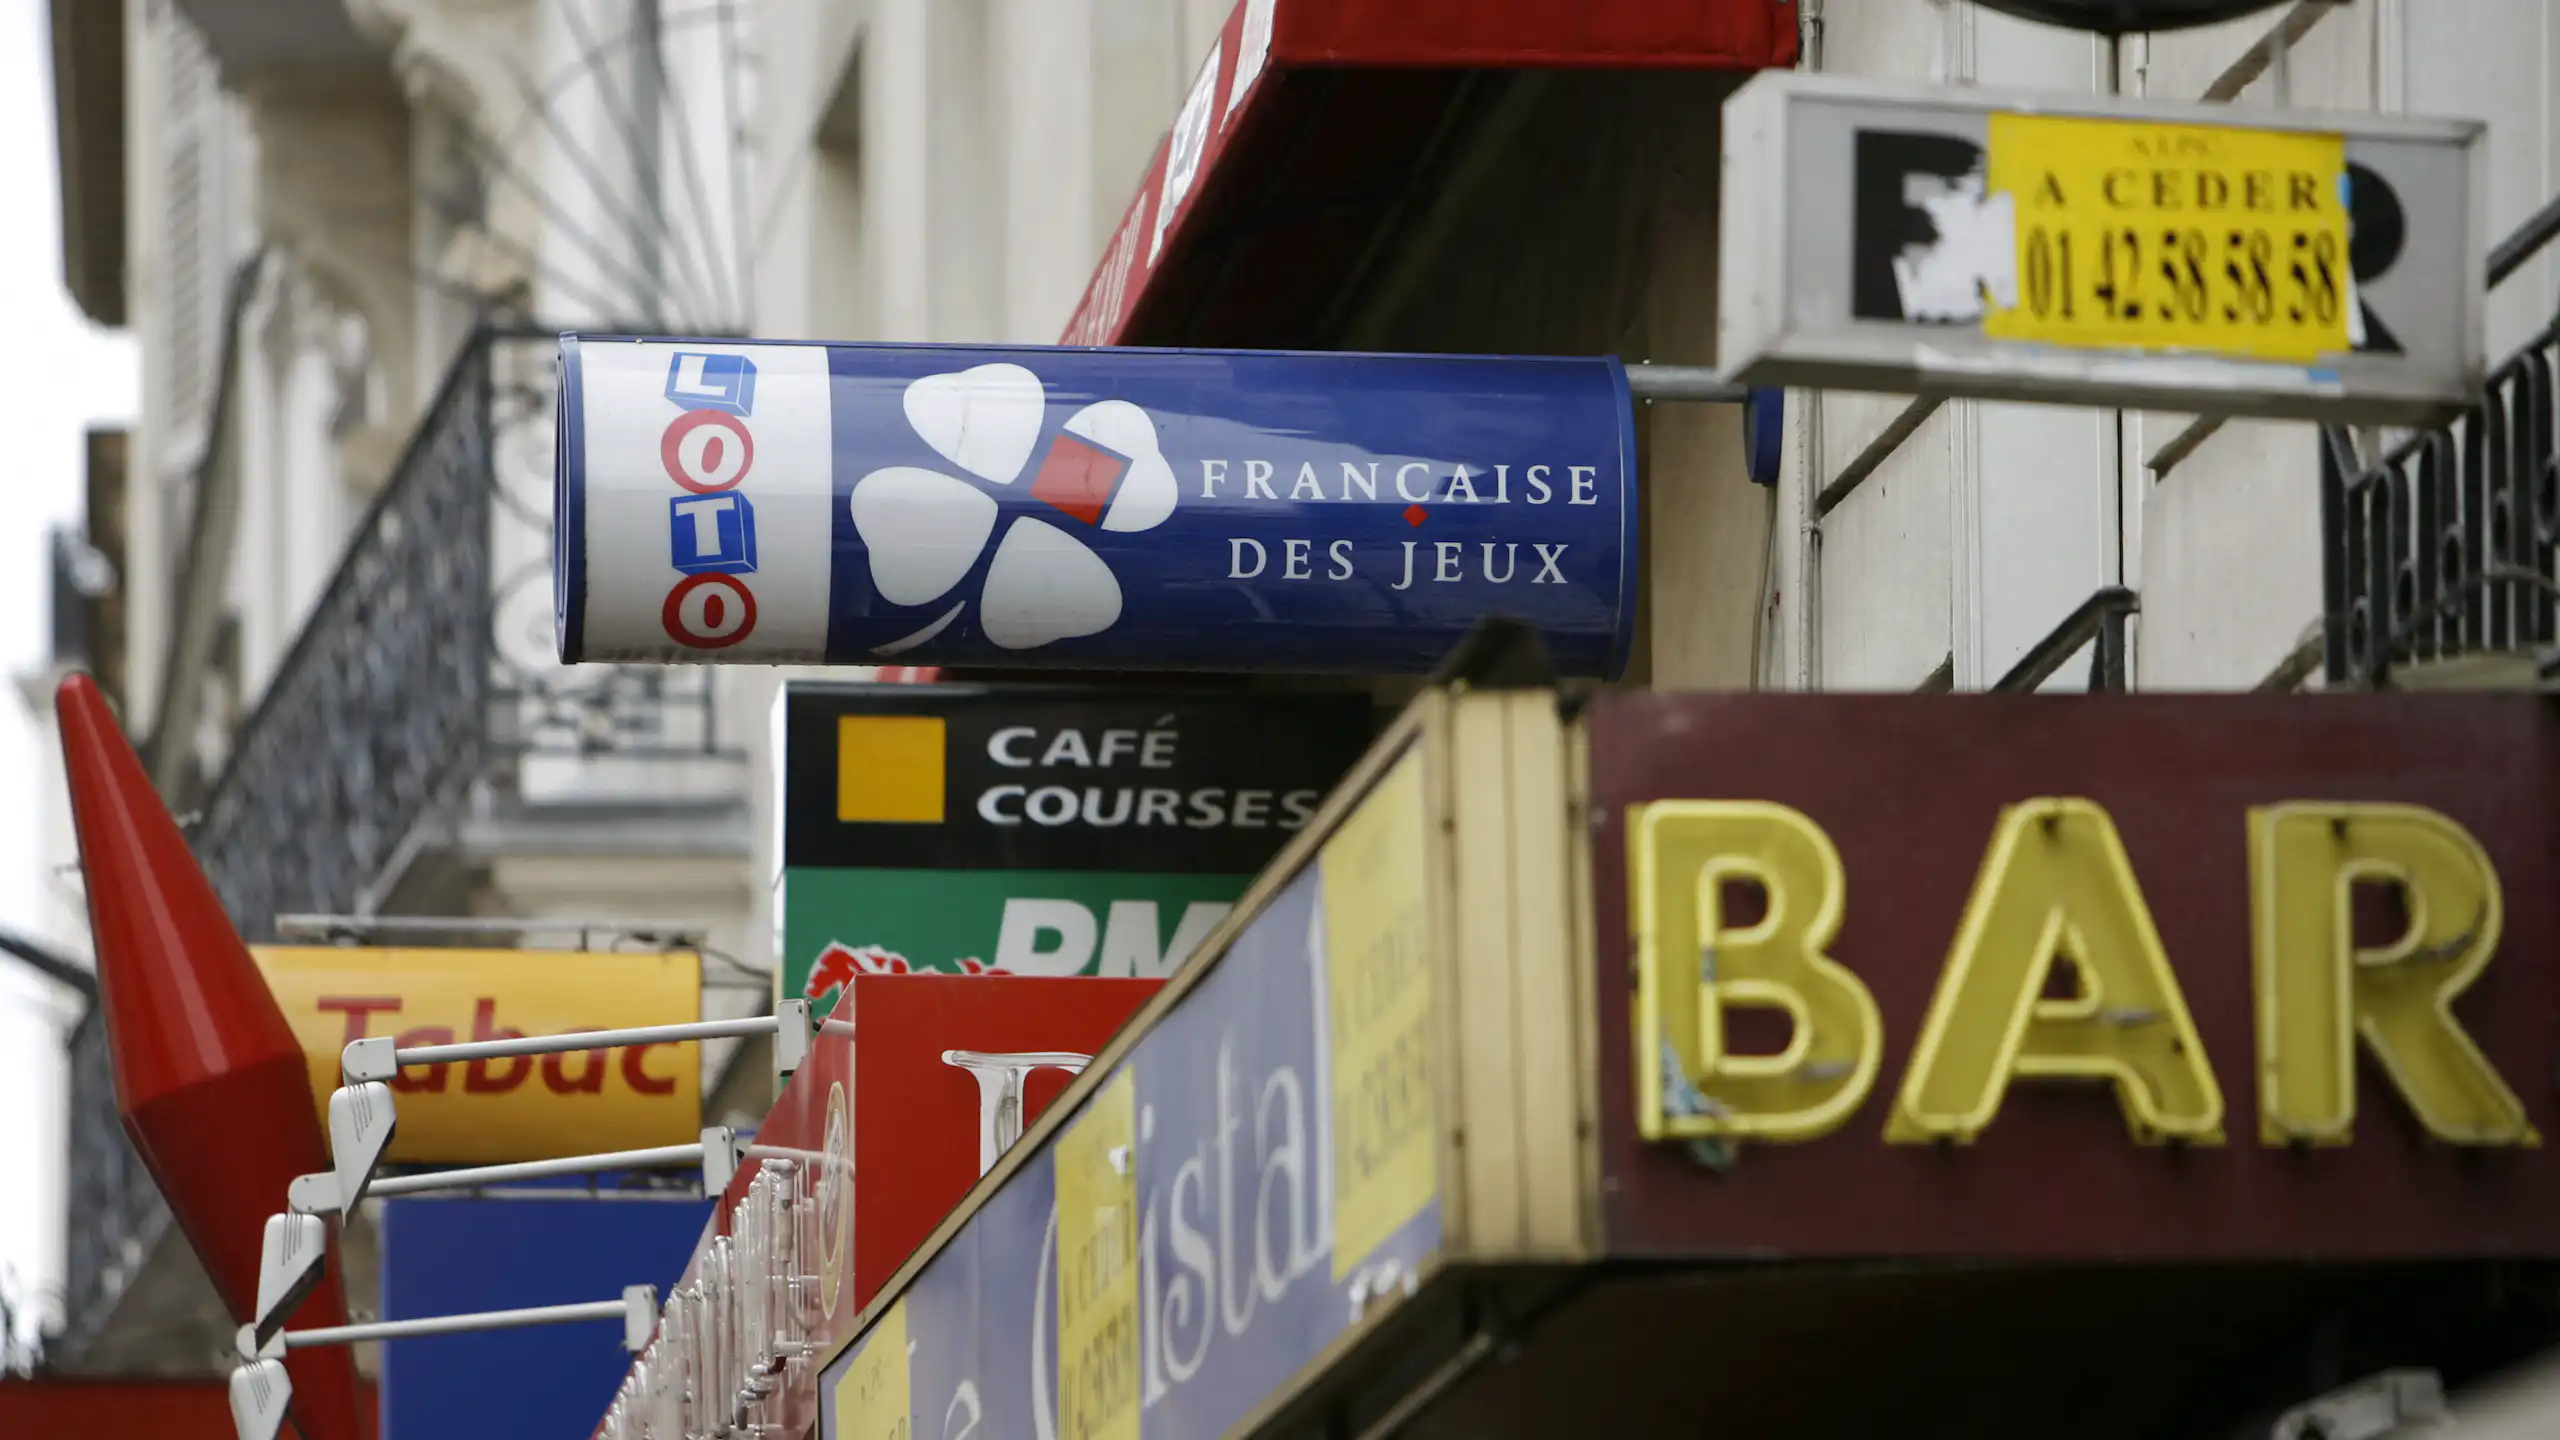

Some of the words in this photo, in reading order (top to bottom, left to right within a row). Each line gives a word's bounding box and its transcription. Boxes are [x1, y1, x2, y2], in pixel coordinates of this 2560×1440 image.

[2032, 169, 2067, 208] A
[2102, 167, 2320, 212] CEDER
[2026, 223, 2074, 324] 01
[2094, 227, 2142, 319] 42
[2158, 229, 2209, 324] 58
[2223, 229, 2274, 326] 58
[2287, 229, 2338, 328] 58
[661, 352, 757, 648] LOTO
[1227, 537, 1355, 581] DES
[1391, 541, 1569, 590] JEUX
[987, 713, 1179, 768] CAFÉ
[976, 785, 1320, 829] COURSES
[1626, 797, 2542, 1148] BAR
[317, 996, 681, 1096] Tabac
